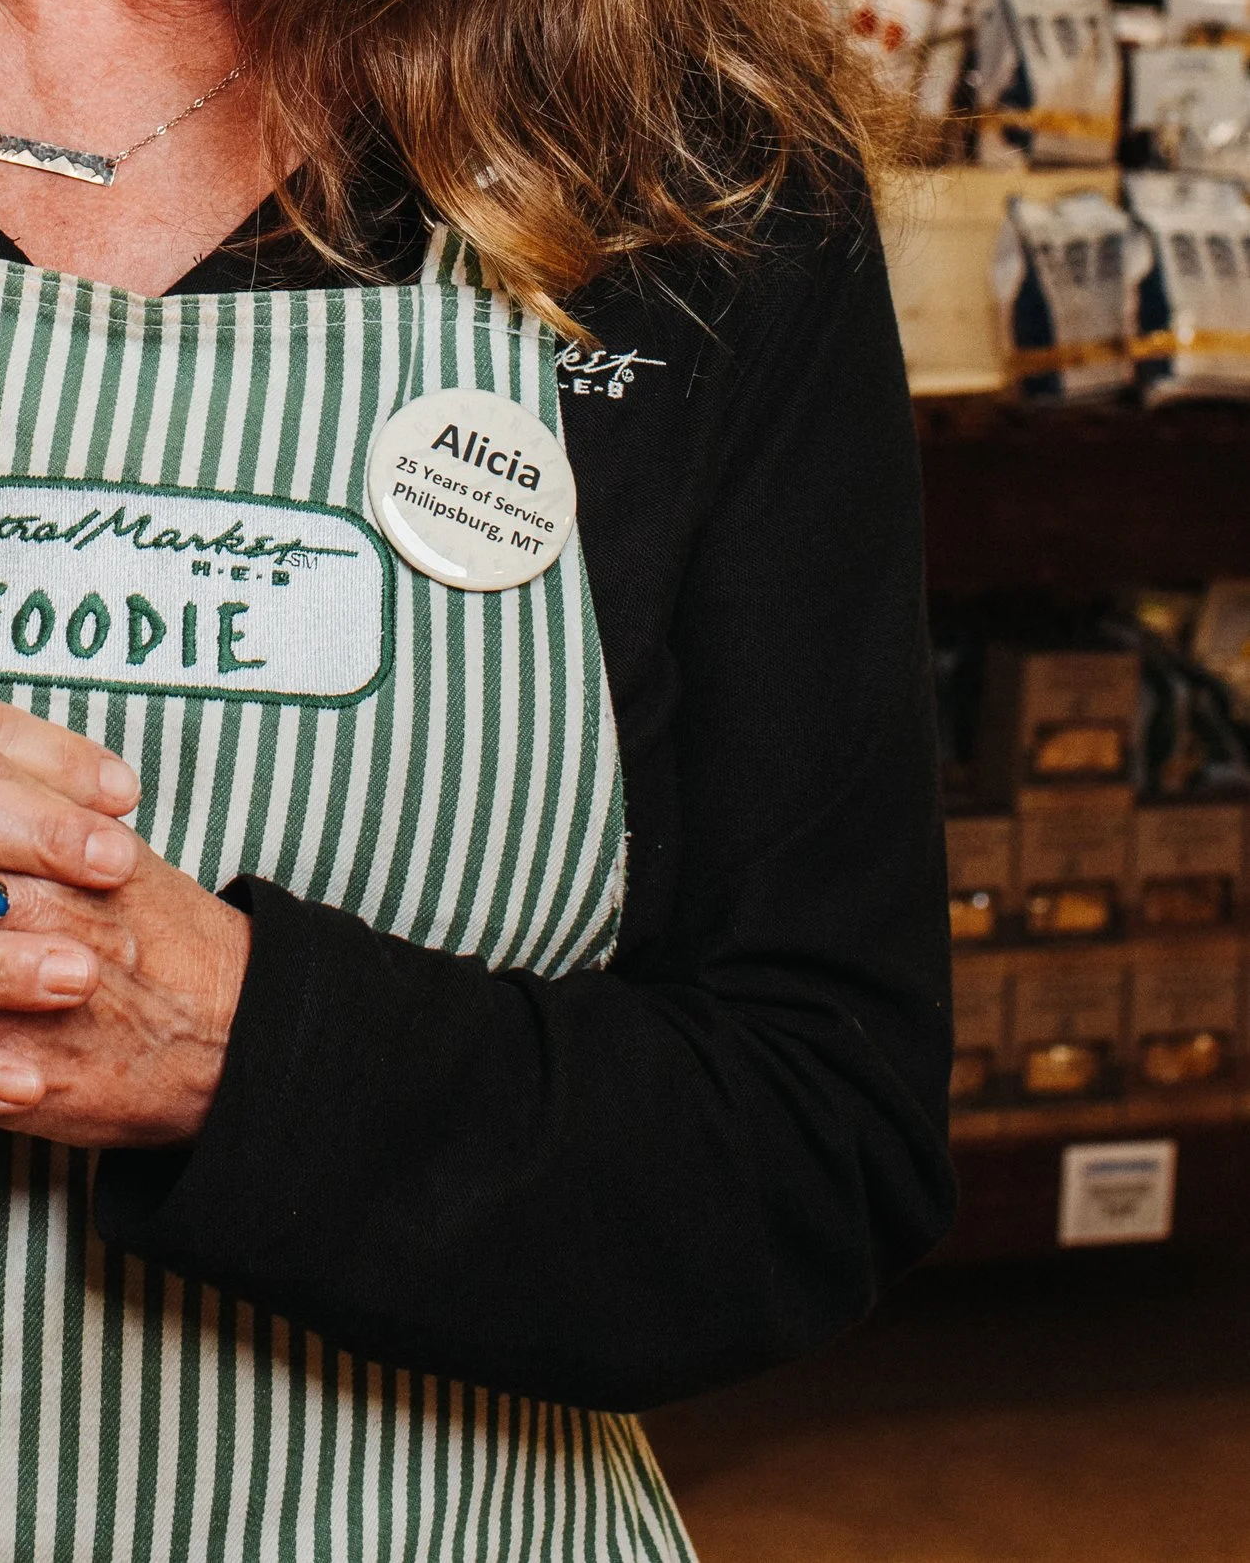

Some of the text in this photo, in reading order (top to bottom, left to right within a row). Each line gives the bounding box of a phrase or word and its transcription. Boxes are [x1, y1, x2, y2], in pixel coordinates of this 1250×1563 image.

[396, 456, 555, 533] 25 Years of Service
[431, 424, 541, 491] Alicia
[392, 482, 504, 543] Philipsburg,
[510, 530, 544, 556] MT
